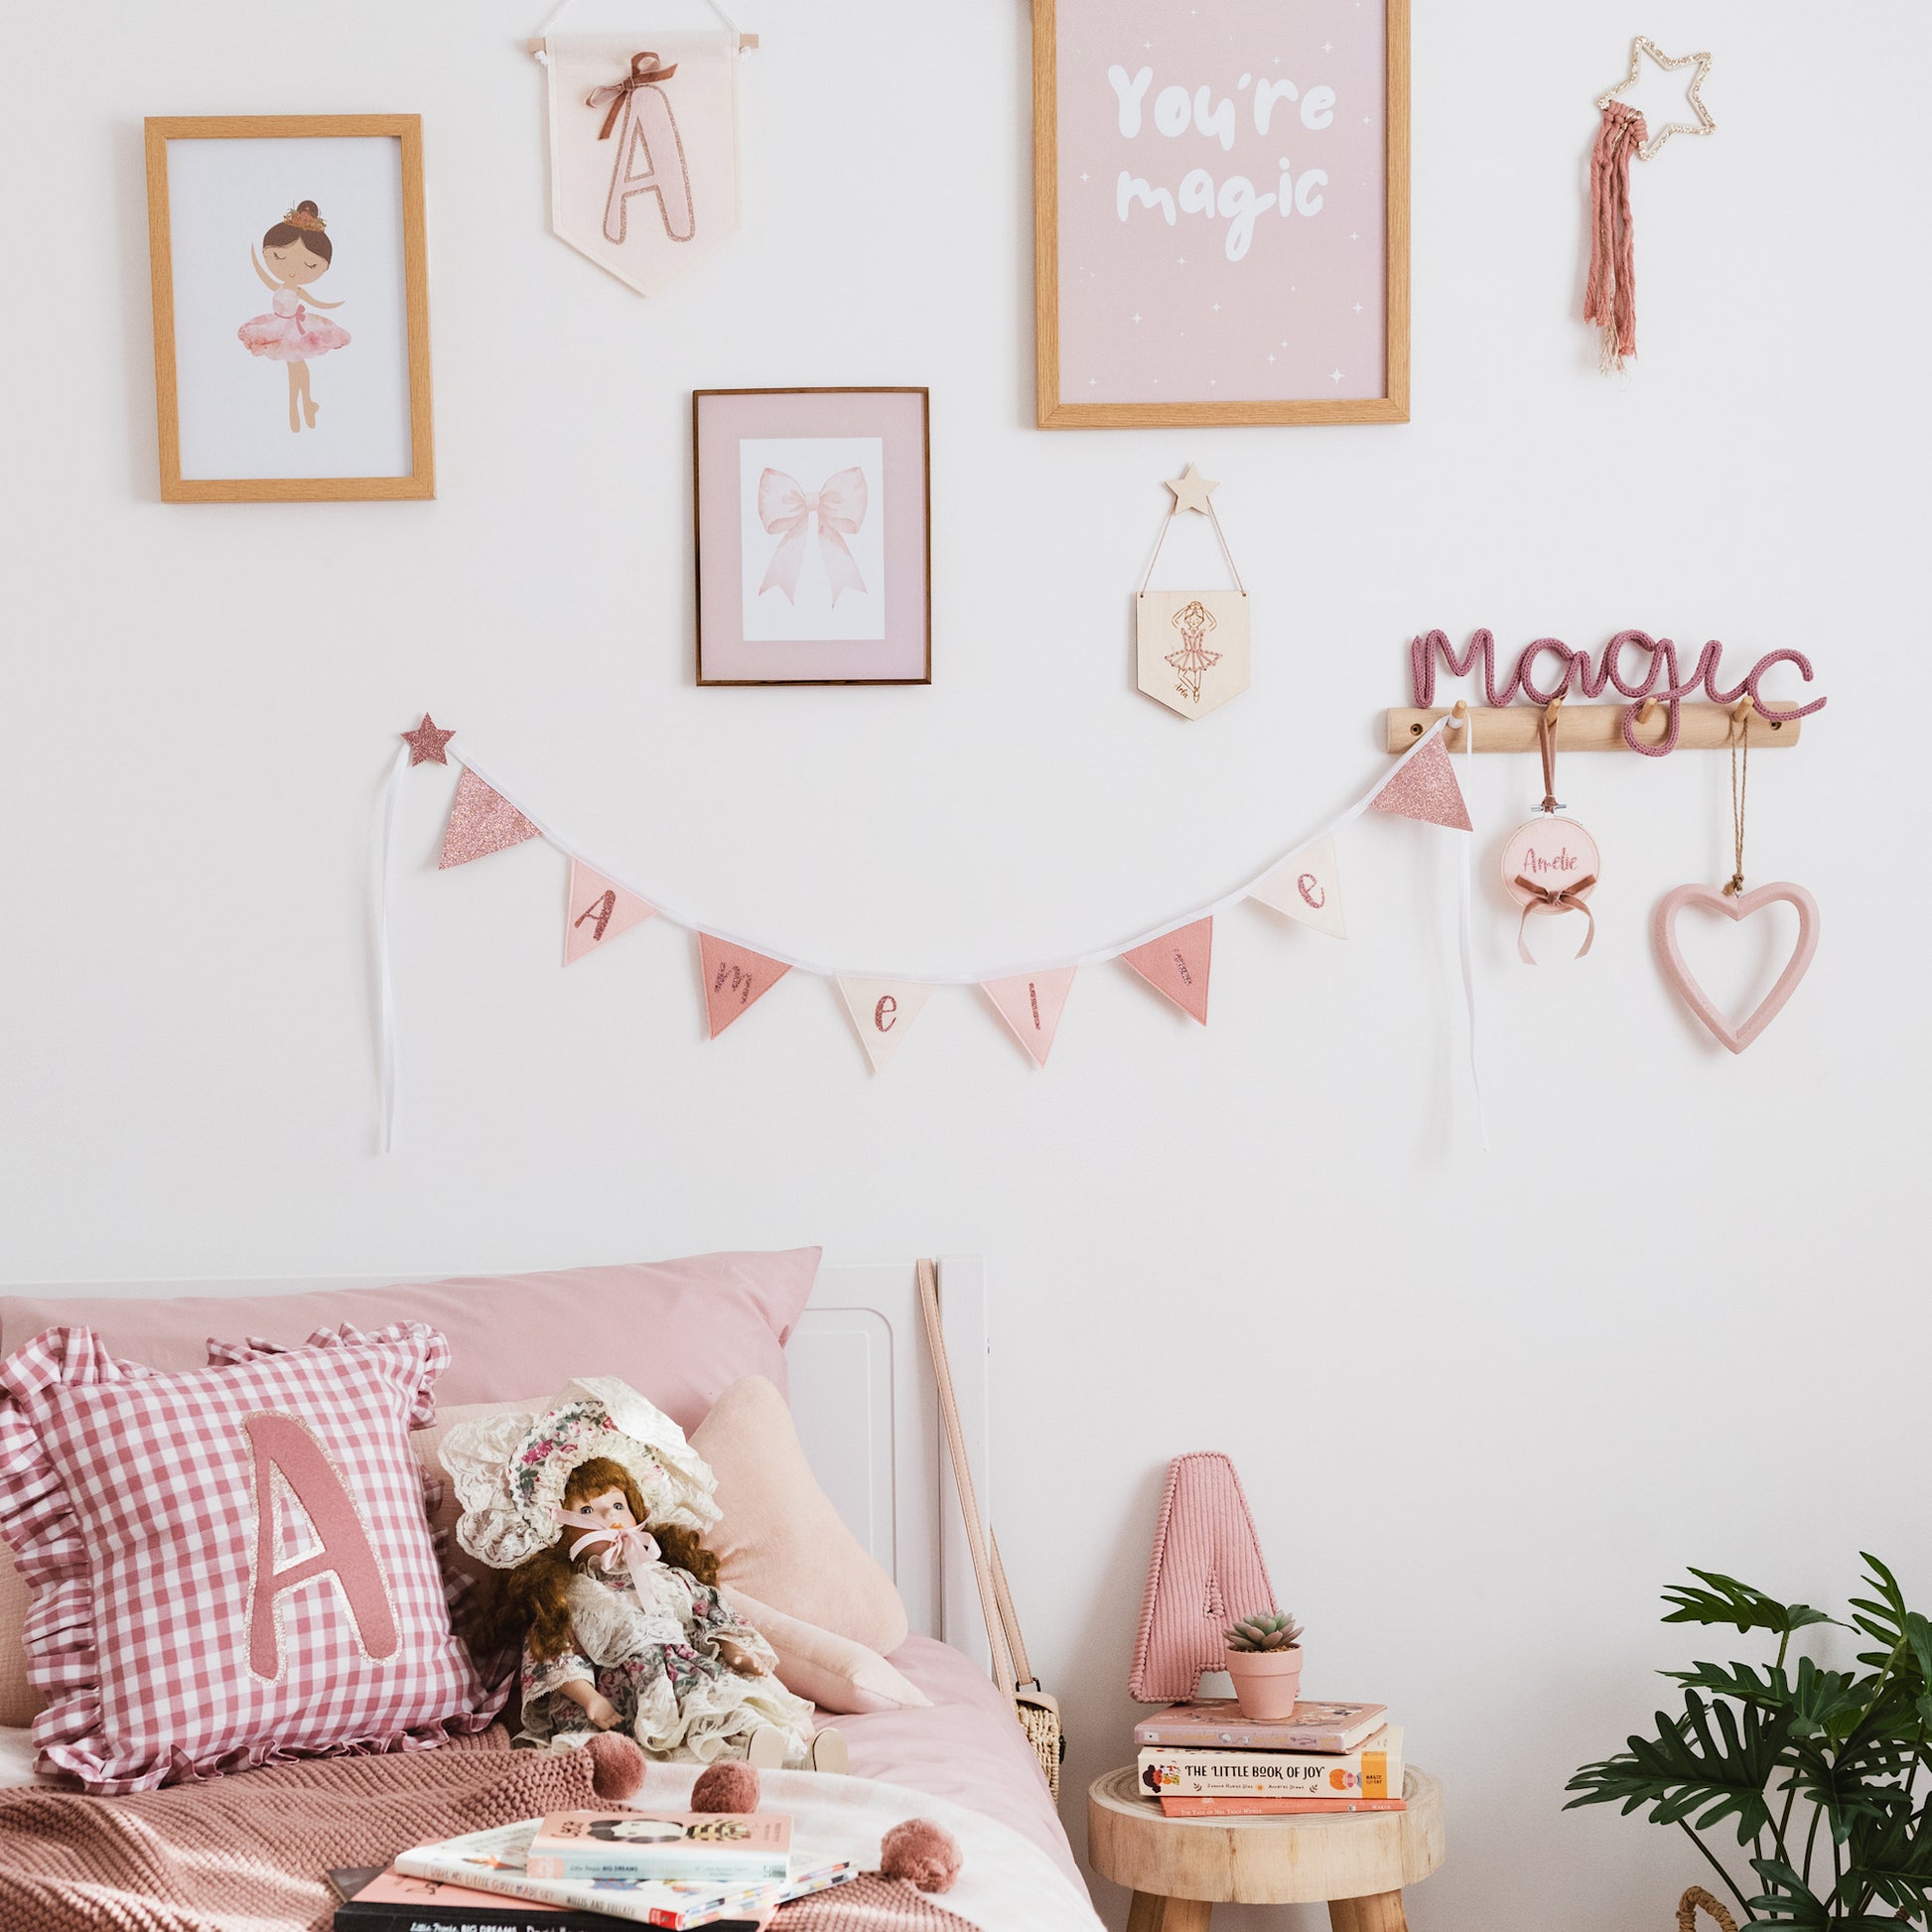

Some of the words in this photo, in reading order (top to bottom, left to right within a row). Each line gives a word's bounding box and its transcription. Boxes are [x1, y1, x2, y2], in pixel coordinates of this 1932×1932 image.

[603, 83, 696, 245] A
[1107, 65, 1337, 151] You're
[1116, 157, 1329, 263] magic
[1411, 627, 1828, 758] Magic
[1522, 847, 1579, 874] Amelie
[239, 1409, 403, 1687] A
[1128, 1450, 1301, 1703] A
[1184, 1765, 1208, 1777] THE
[1211, 1765, 1249, 1778] LITTLE
[1252, 1765, 1284, 1780] BOOK
[1287, 1766, 1301, 1778] OF
[1303, 1766, 1325, 1780] JOY
